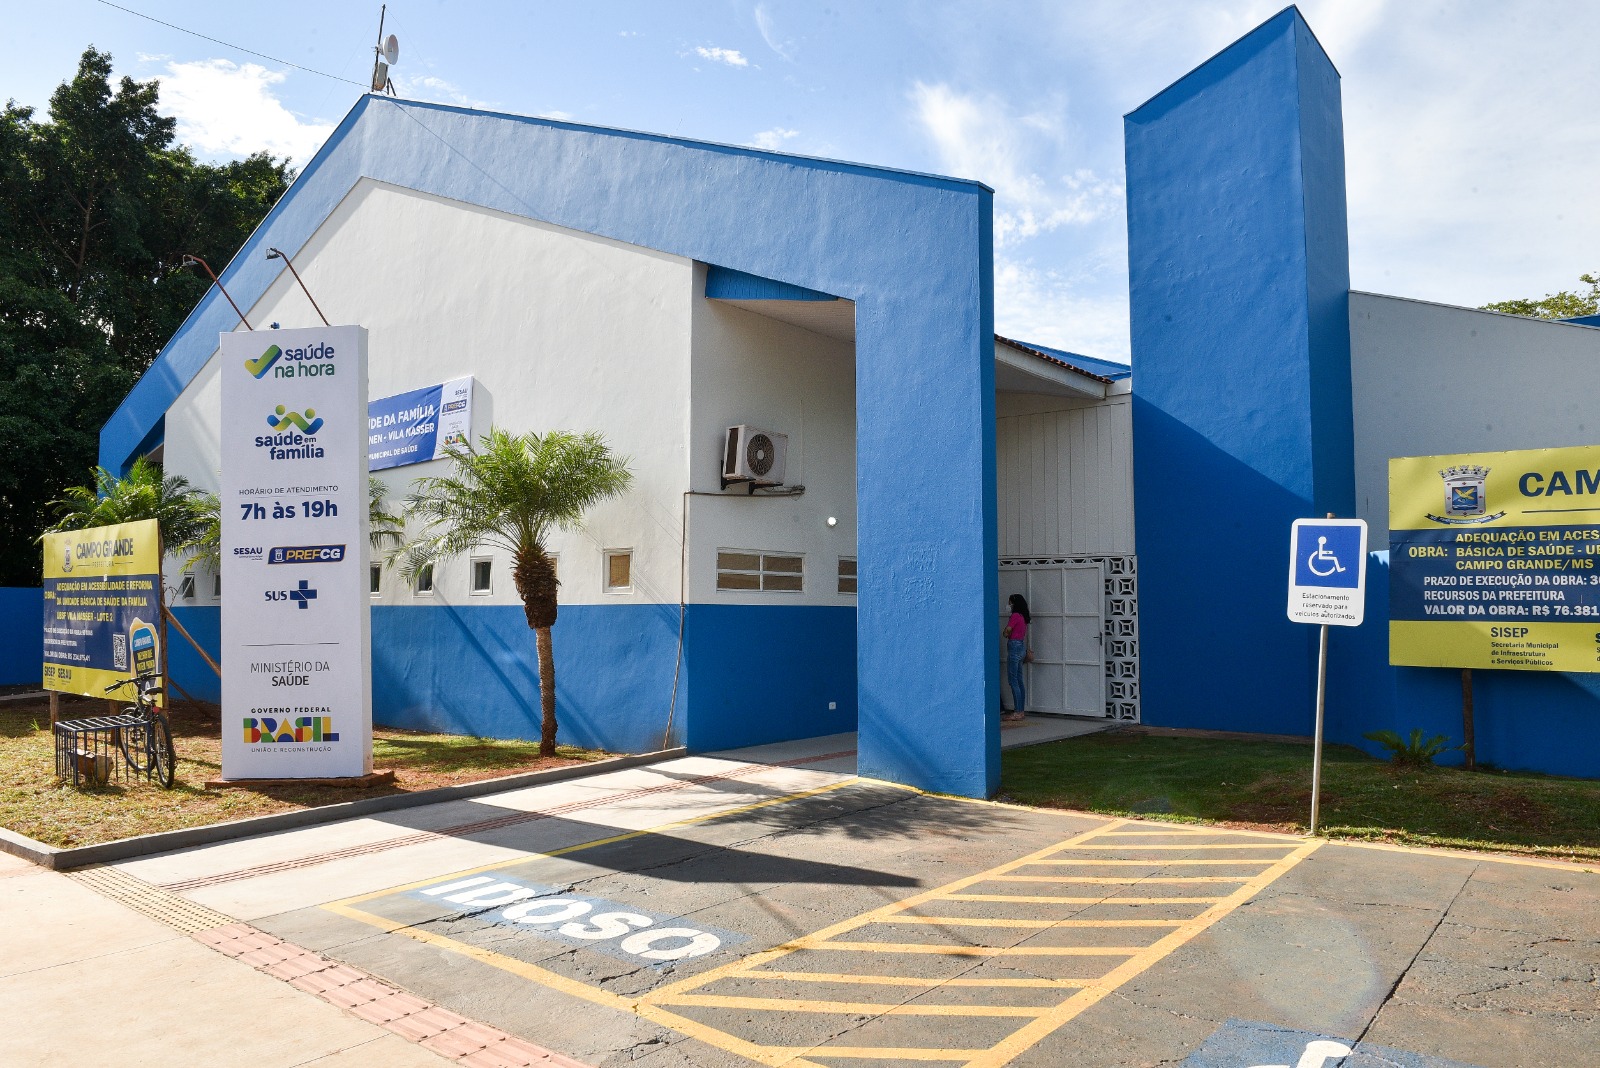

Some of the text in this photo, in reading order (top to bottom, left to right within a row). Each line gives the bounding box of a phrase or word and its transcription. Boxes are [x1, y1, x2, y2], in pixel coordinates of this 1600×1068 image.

[285, 342, 335, 361] saúde
[275, 362, 335, 378] na hora
[384, 413, 396, 426] DA
[398, 404, 434, 424] FAMÍLIA
[388, 429, 404, 440] VILA
[406, 422, 434, 438] NASSER
[255, 431, 303, 448] saúde
[270, 445, 324, 460] família
[401, 444, 418, 454] SAÚDE
[238, 488, 272, 496] HORÁRIO
[286, 486, 338, 494] ATENDIMENTO
[240, 500, 338, 520] 7h às 19h
[1456, 530, 1536, 544] ADEQUAÇÃO
[1540, 531, 1560, 541] EM
[76, 538, 134, 560] CAMPO GRANDE
[286, 548, 341, 560] PREFCG
[1408, 546, 1448, 558] OBRA:
[1456, 546, 1504, 557] BÁSICA
[1508, 547, 1524, 556] DE
[1528, 543, 1574, 556] SAÚDE
[1456, 560, 1504, 570] CAMPO
[81, 582, 88, 590] EM
[88, 580, 126, 590] ACESSIBILIDADE
[130, 580, 152, 590] REFORMA
[1424, 576, 1457, 586] PRAZO
[1460, 576, 1474, 586] DE
[1476, 573, 1532, 588] EXECUÇÃO
[1535, 576, 1550, 586] DA
[1552, 575, 1588, 586] OBRA:
[80, 595, 96, 606] BÁSICA
[97, 597, 103, 606] DE
[104, 595, 120, 606] SAÚDE
[128, 595, 148, 606] FAMÍLIA
[265, 590, 288, 602] SUS
[1302, 592, 1350, 601] Estacionamento
[1424, 590, 1566, 600] RECURSOS DA PREFEITURA
[1320, 612, 1356, 620] autorizados
[1424, 605, 1465, 615] VALOR
[1468, 606, 1486, 615] DA
[1488, 606, 1529, 616] OBRA:
[1532, 605, 1550, 616] R$
[1490, 626, 1529, 638] SISEP
[250, 660, 330, 674] MINISTÉRIO DA
[1496, 658, 1524, 666] Serviços
[272, 673, 310, 686] SAÚDE
[243, 716, 340, 744] BRASIL
[418, 876, 721, 960] IDOSO
